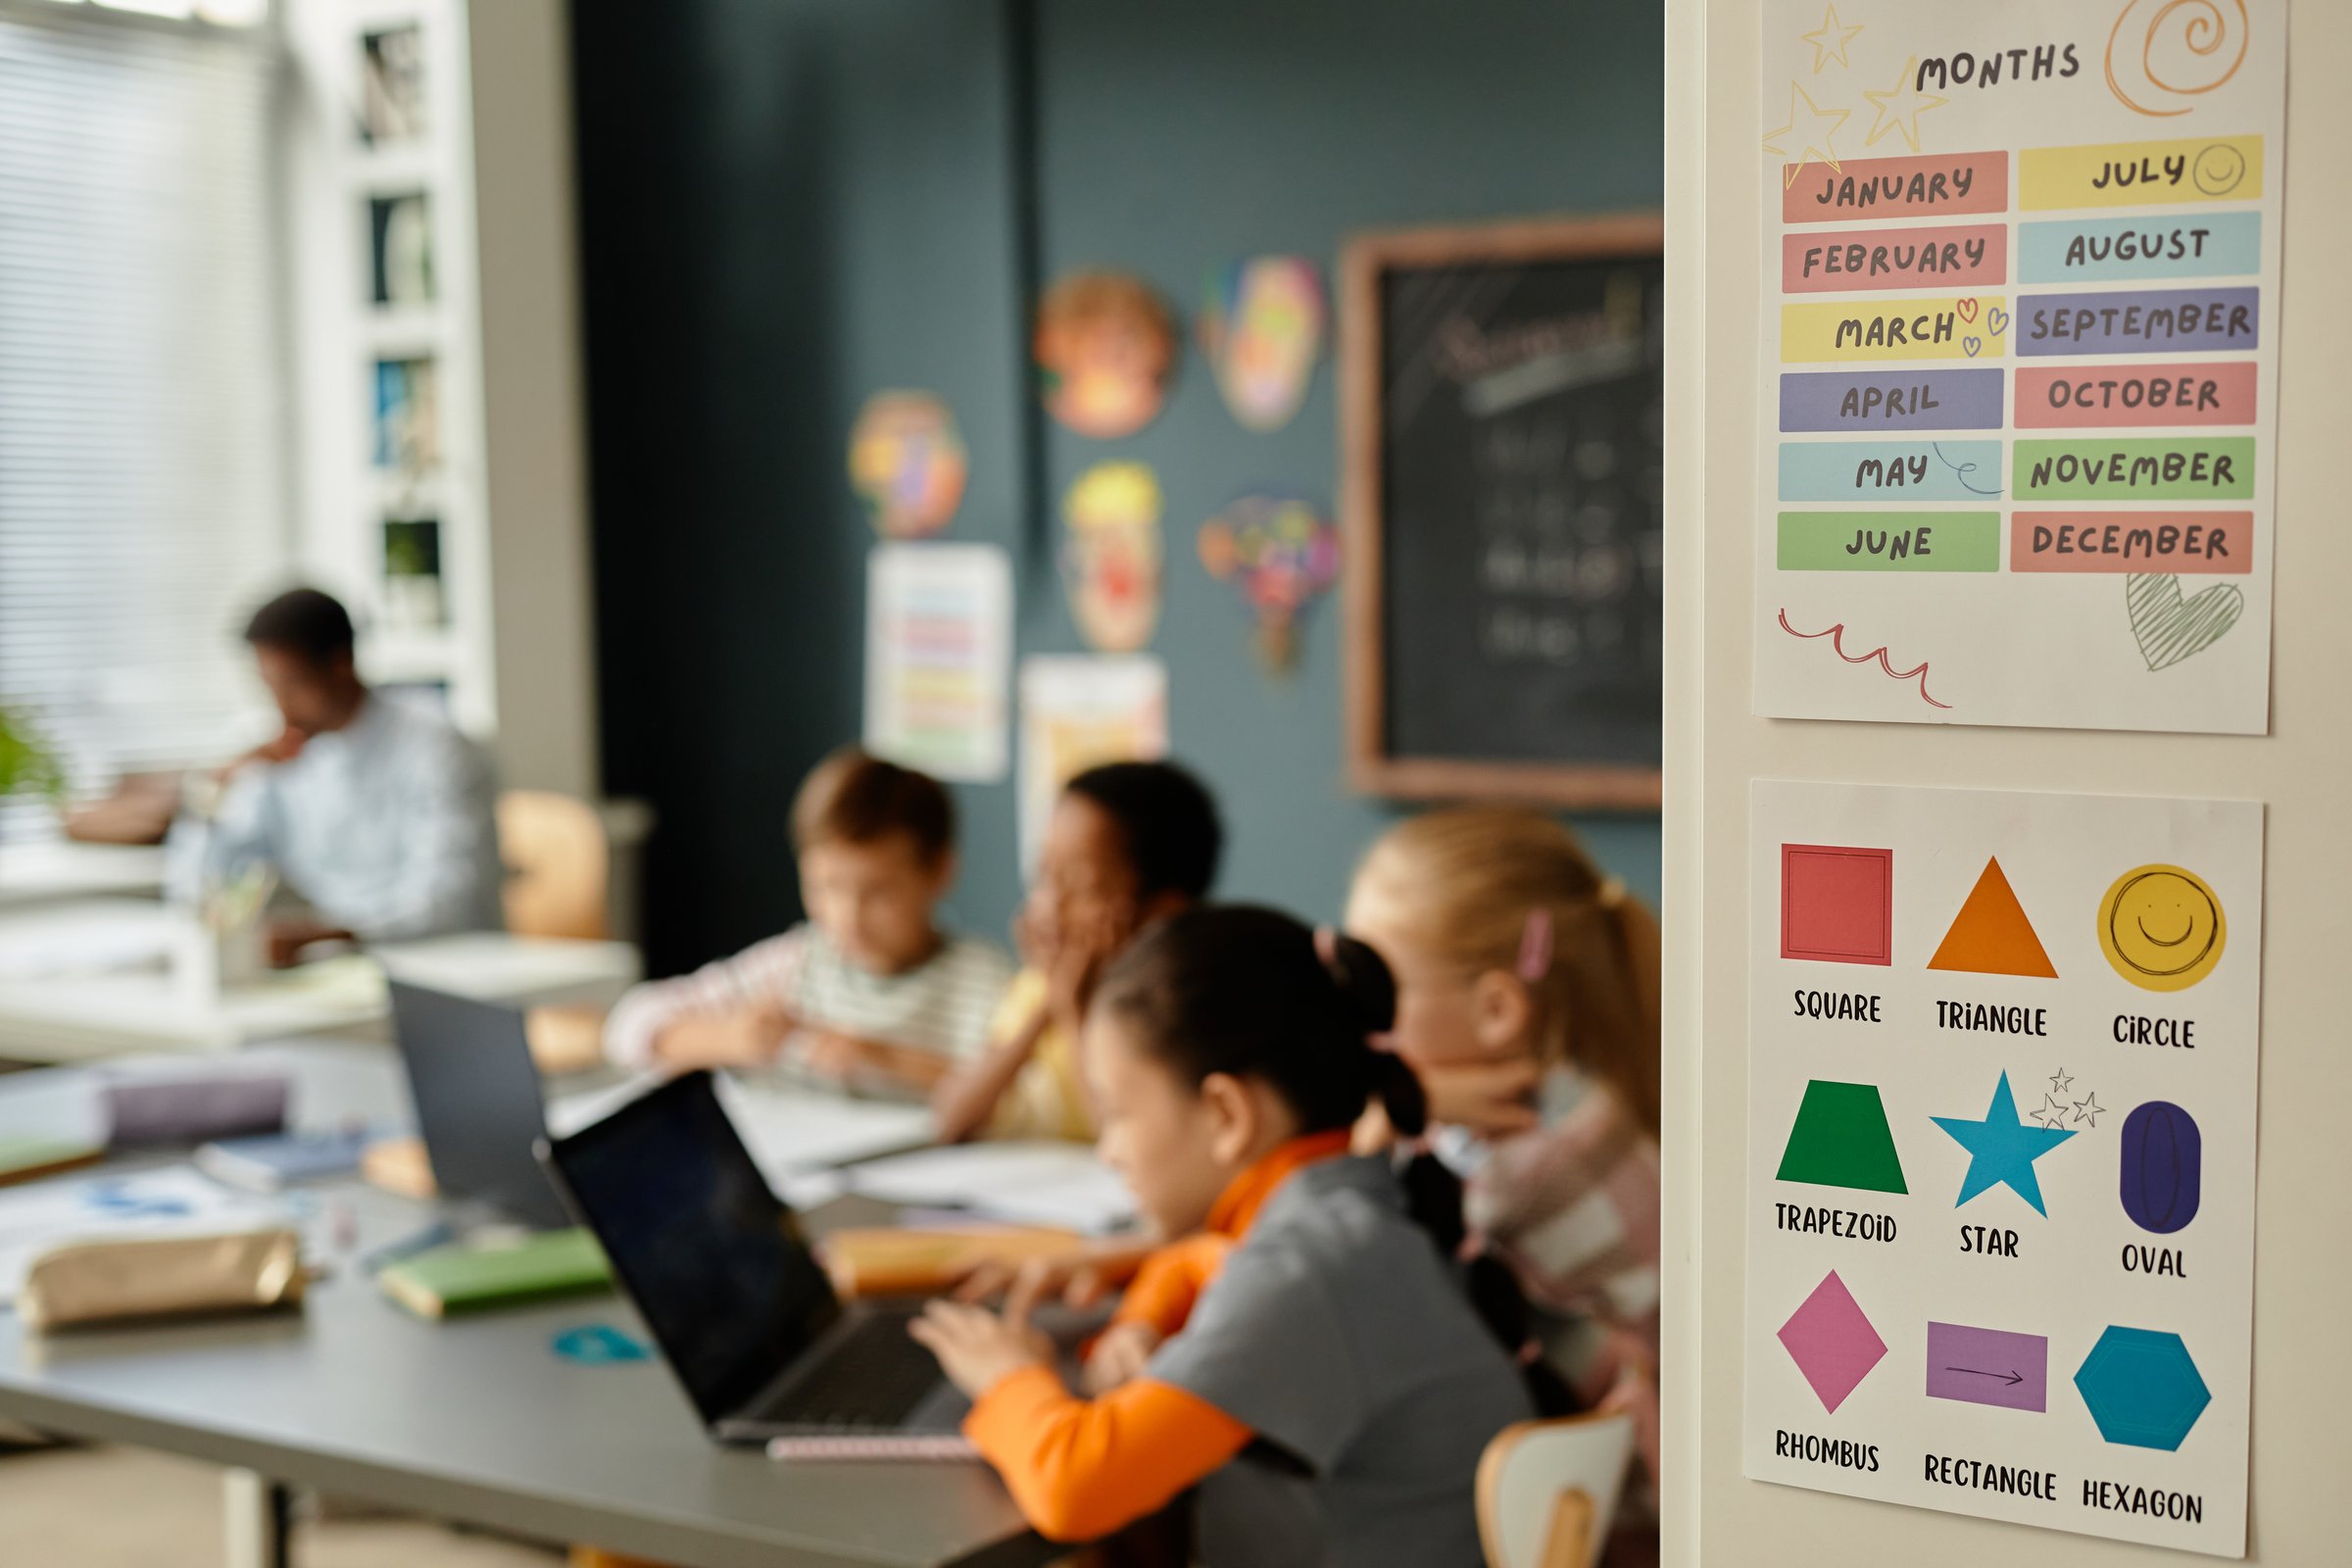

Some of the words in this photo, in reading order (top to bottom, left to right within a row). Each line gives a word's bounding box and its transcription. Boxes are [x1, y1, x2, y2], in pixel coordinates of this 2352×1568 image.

[1916, 43, 2080, 92] MONTHS
[1816, 167, 1974, 209] JANUARY
[2091, 154, 2185, 189] JULY
[1802, 237, 1985, 278] FEBRUARY
[2065, 228, 2211, 267] AUGUST
[1835, 312, 1955, 349] MARCH
[2030, 304, 2252, 342] SEPTEMBER
[1839, 384, 1939, 419] APRIL
[2048, 376, 2221, 413] OCTOBER
[1855, 455, 1929, 489] MAY
[2030, 452, 2235, 489] NOVEMBER
[1845, 526, 1933, 562] JUNE
[2033, 524, 2230, 561] DECEMBER
[1793, 989, 1882, 1023] SQUARE
[1960, 1224, 2019, 1258] STAR
[2122, 1244, 2187, 1279] OVAL
[1776, 1429, 1880, 1473] RHOMBUS
[1924, 1453, 2057, 1501] RECTANGLE
[2082, 1479, 2202, 1524] HEXAGON
